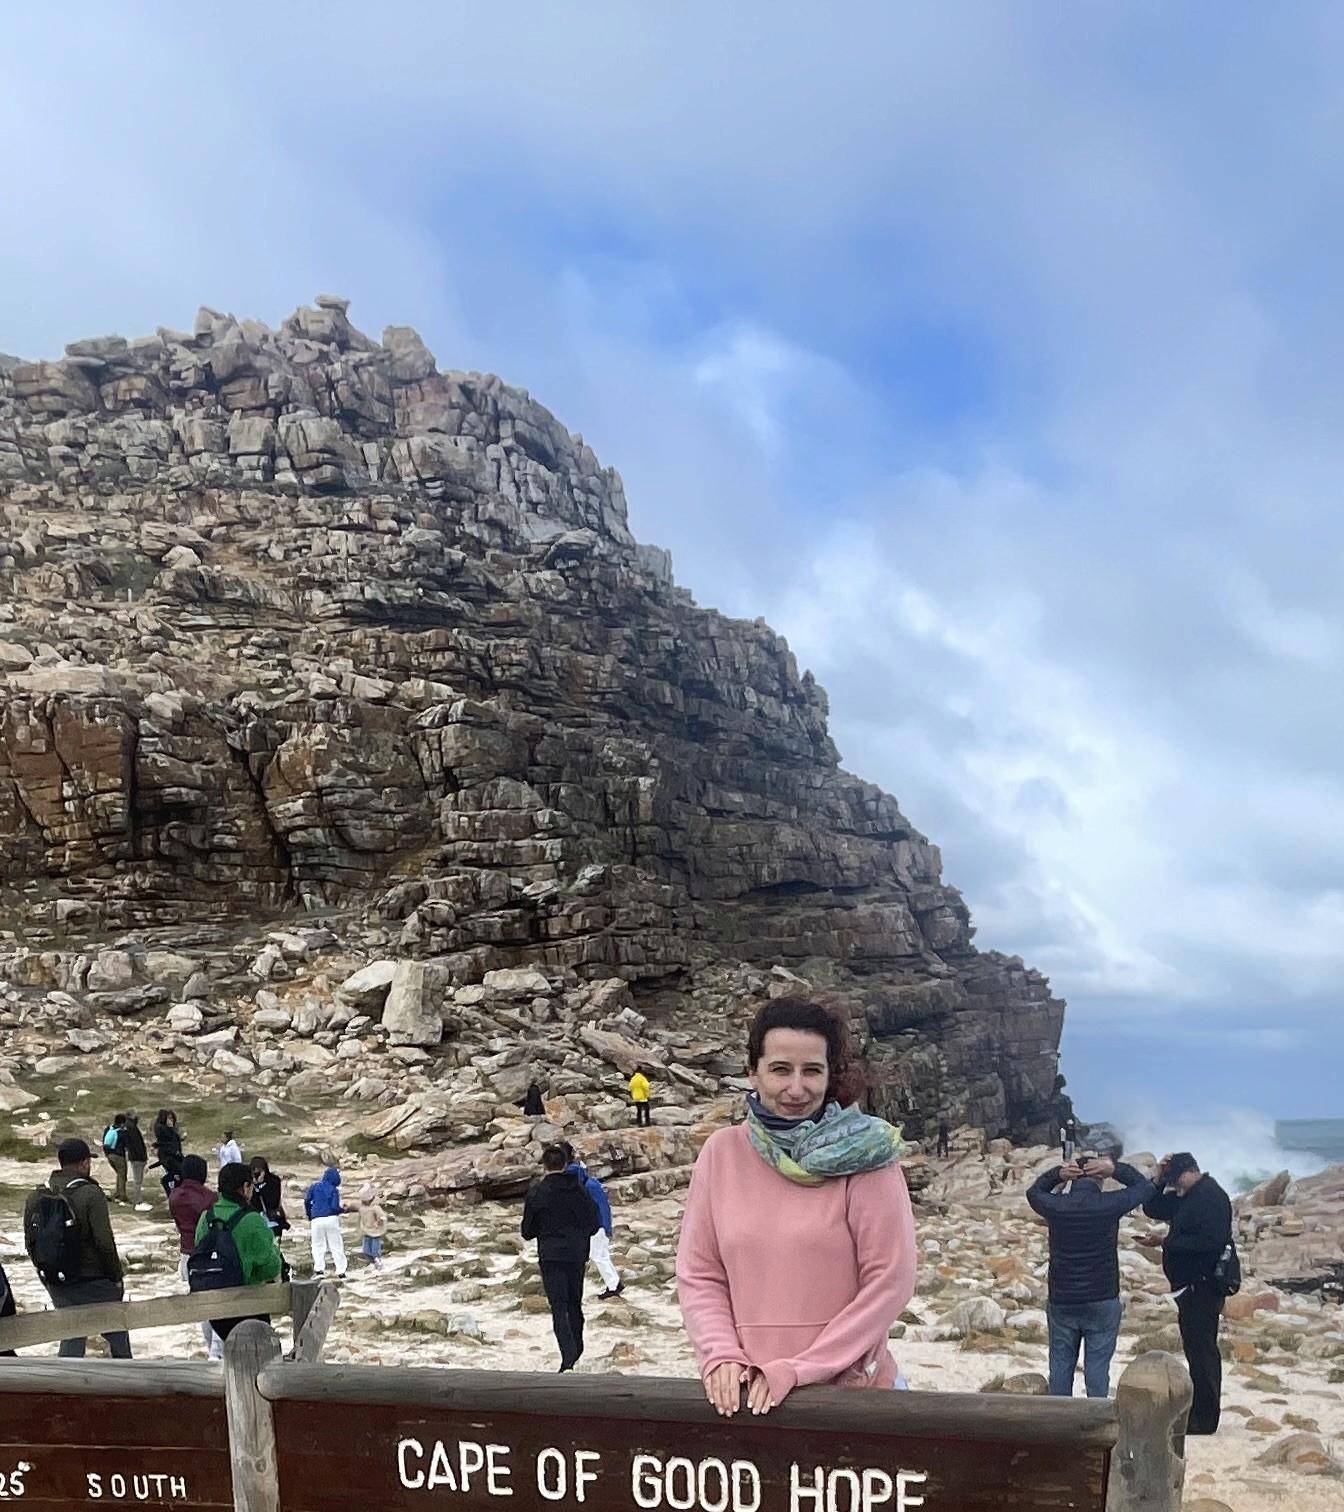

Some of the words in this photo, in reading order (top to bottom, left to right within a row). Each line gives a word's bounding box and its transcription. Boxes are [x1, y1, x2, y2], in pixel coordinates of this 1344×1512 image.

[86, 1471, 188, 1500] SOUTH
[396, 1437, 514, 1497] CAPE
[536, 1447, 601, 1504] OF
